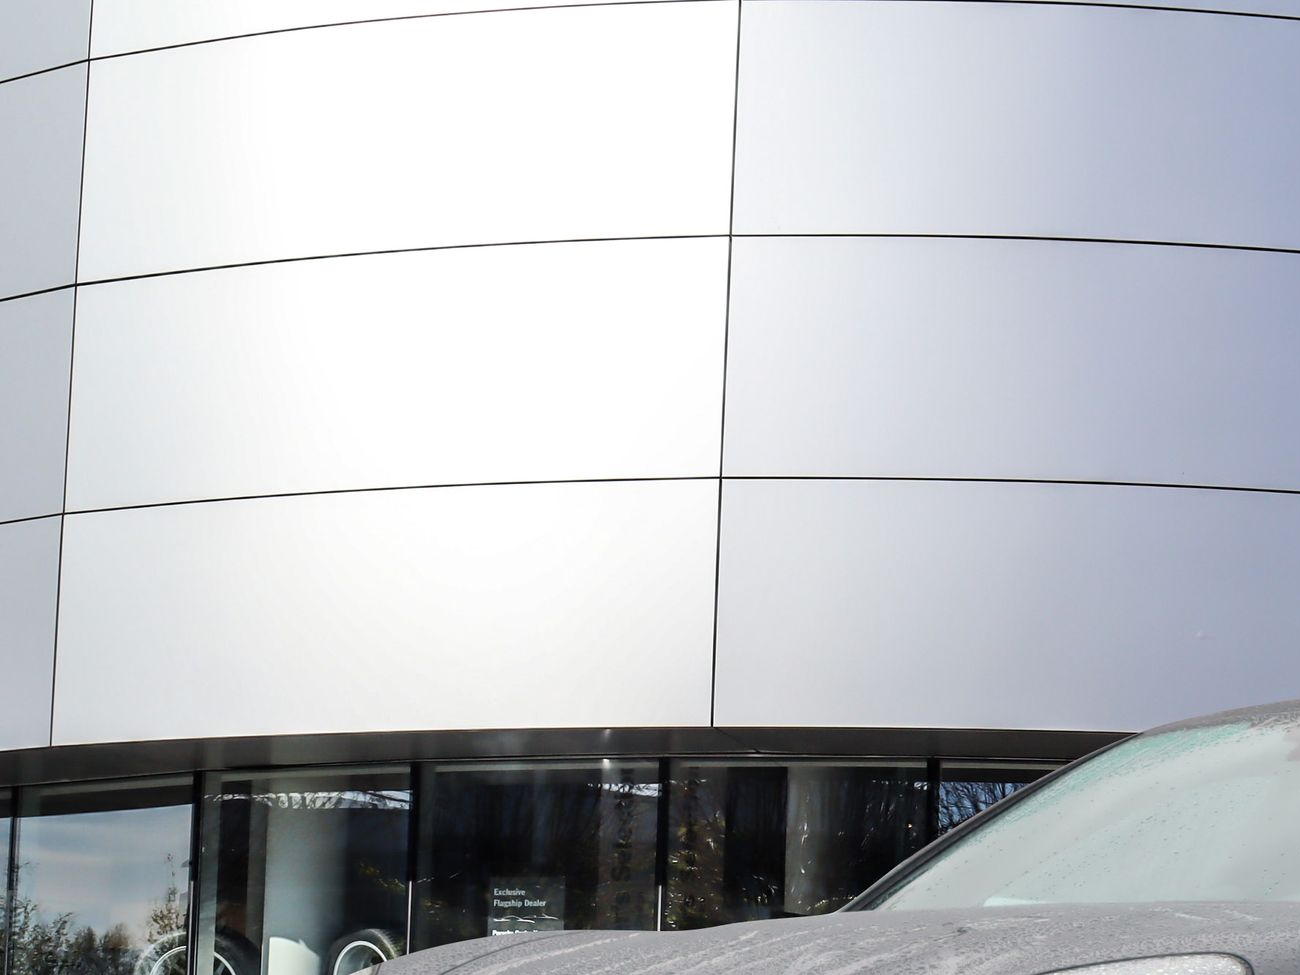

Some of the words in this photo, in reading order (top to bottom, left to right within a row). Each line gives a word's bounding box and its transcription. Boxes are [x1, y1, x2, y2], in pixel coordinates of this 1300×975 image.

[494, 888, 526, 896] Exclusive
[493, 899, 523, 908] Flagship
[524, 899, 546, 907] Dealer
